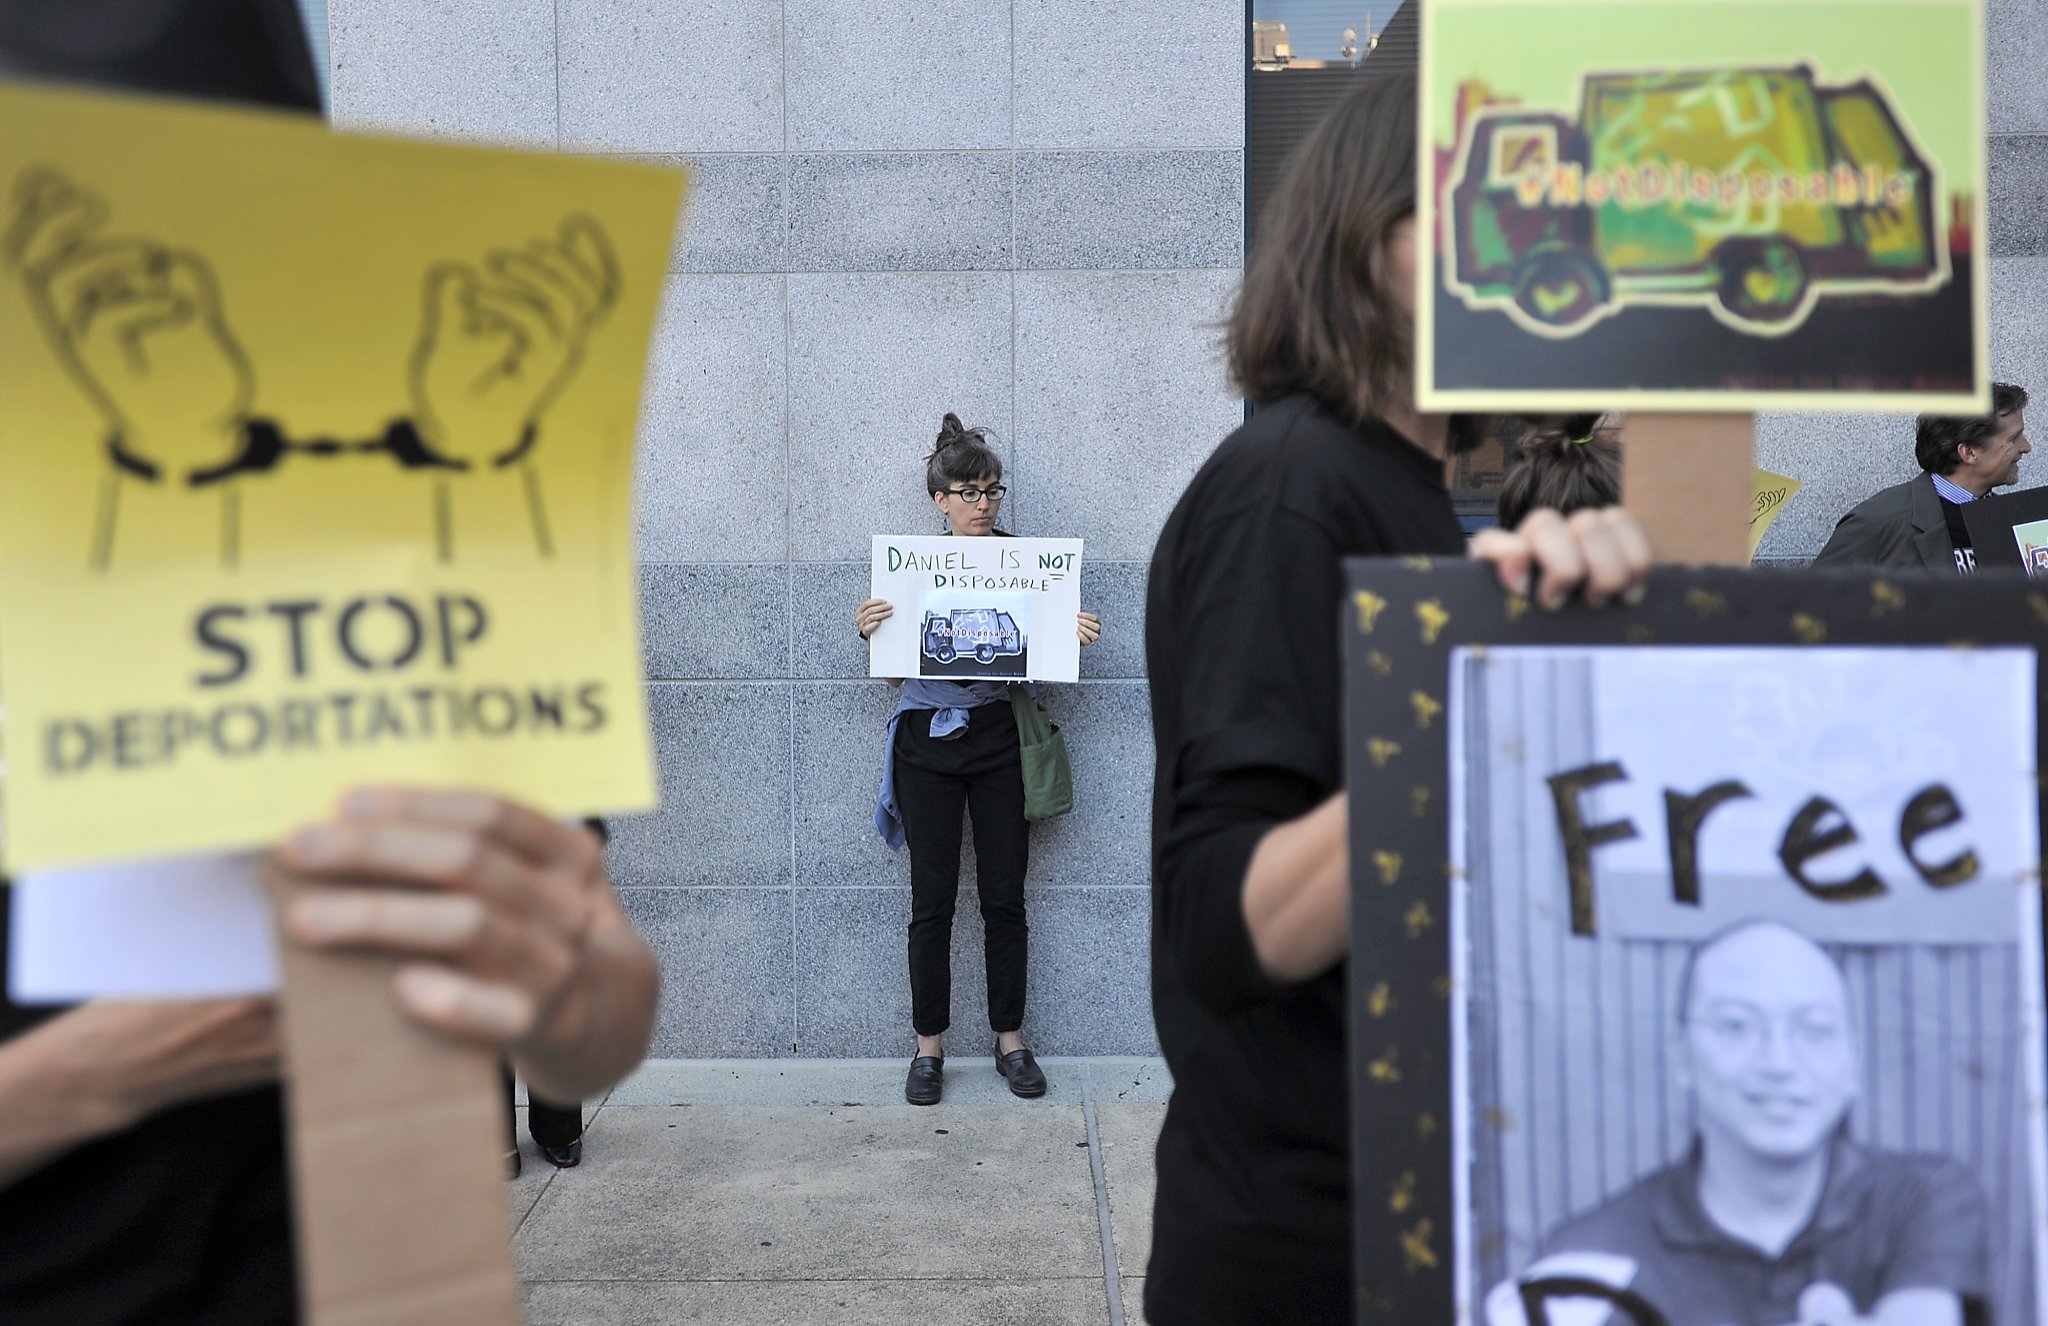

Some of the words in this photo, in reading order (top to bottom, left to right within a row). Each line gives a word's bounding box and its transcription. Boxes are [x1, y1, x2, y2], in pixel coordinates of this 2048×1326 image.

[888, 546, 977, 572] DANIEL
[1000, 549, 1020, 569] IS
[1038, 553, 1076, 572] NOT
[934, 574, 1049, 591] DISPOSABLE
[190, 595, 489, 688] STOP
[43, 680, 609, 776] DEPORTATIONS
[1545, 759, 1981, 939] Free
